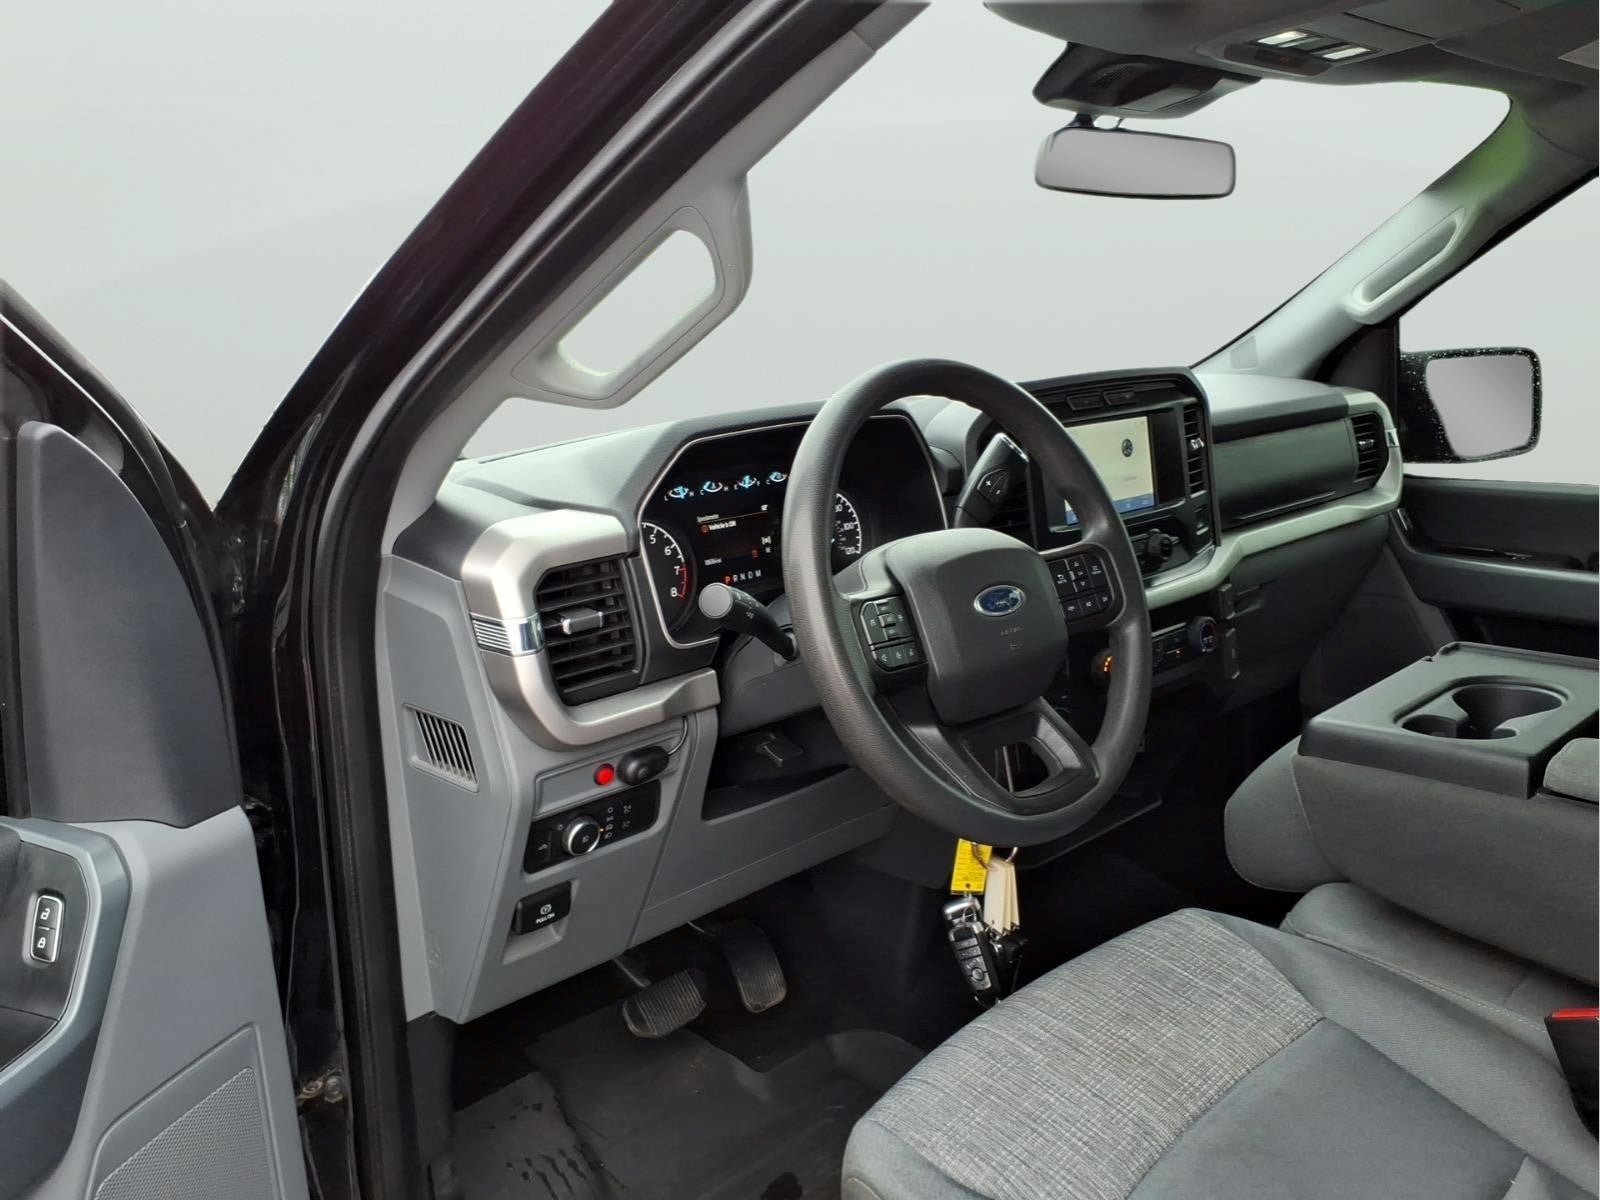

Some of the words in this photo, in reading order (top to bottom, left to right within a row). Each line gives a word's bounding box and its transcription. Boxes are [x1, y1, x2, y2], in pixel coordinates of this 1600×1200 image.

[649, 534, 656, 544] 5
[664, 546, 672, 556] 6
[674, 565, 680, 576] 7
[733, 574, 738, 582] R
[670, 587, 677, 597] 8
